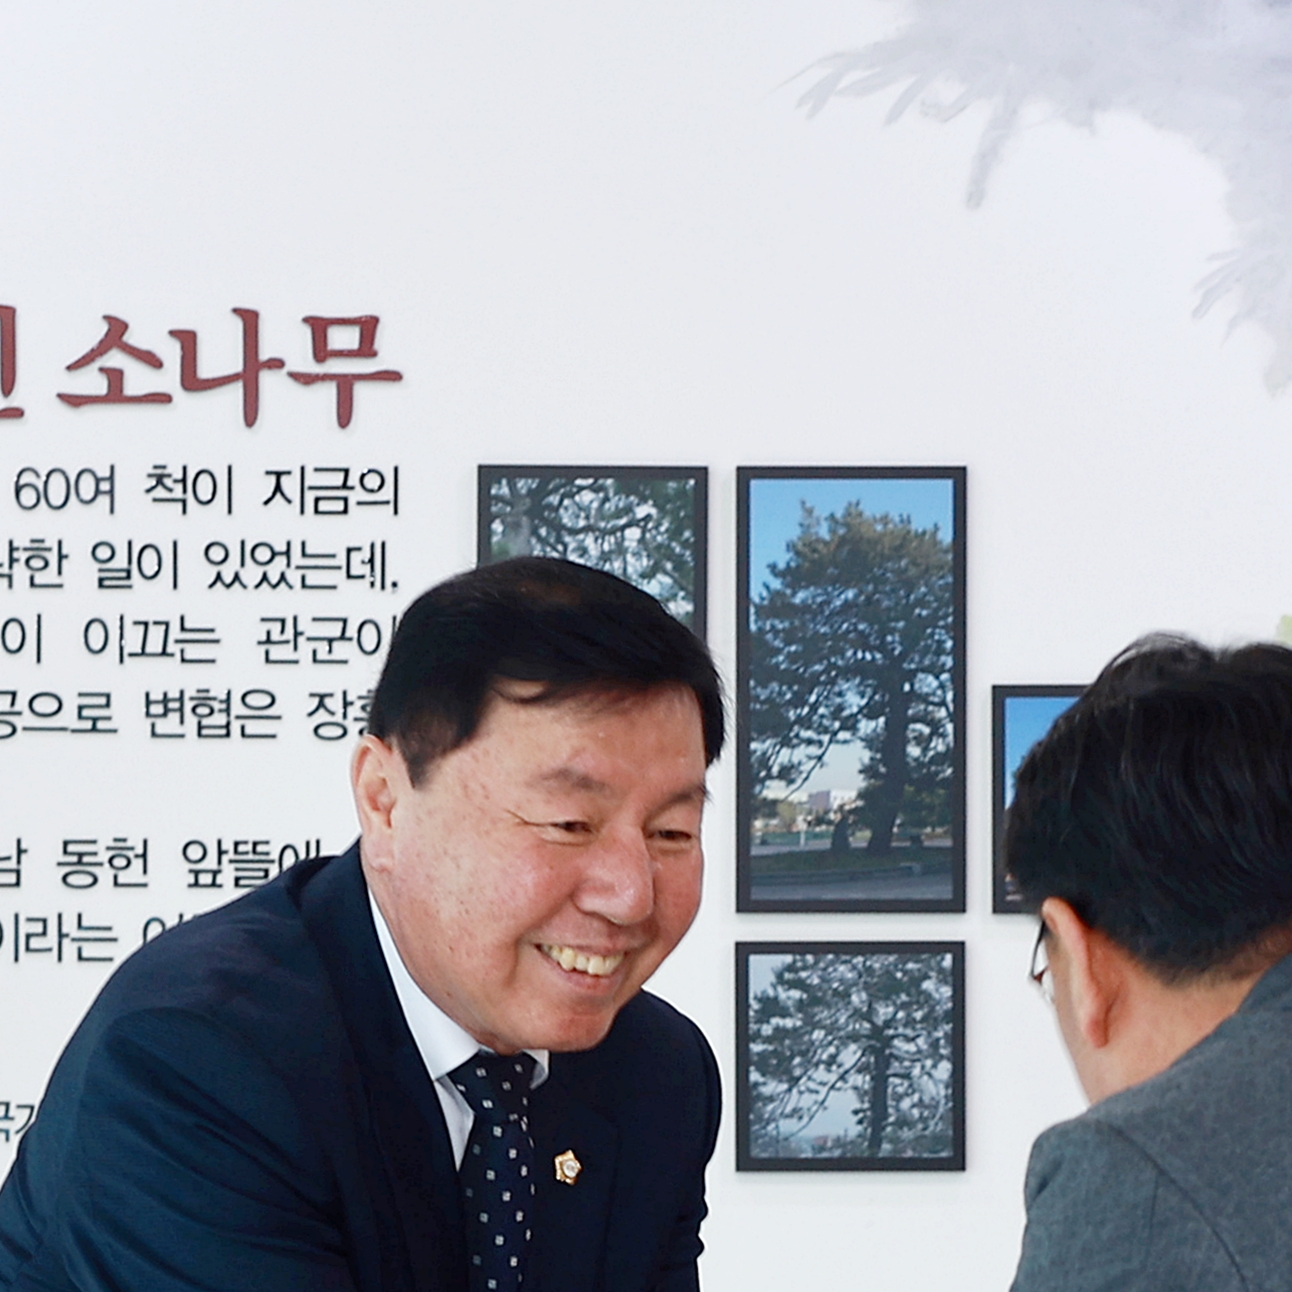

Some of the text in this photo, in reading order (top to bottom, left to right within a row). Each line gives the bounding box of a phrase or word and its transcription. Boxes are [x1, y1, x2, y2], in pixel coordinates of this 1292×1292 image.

[55, 307, 404, 430] 소나무
[13, 463, 116, 516] 60여
[144, 464, 233, 516] 척이
[262, 464, 400, 517] 지금의
[90, 538, 179, 591] 일이
[83, 613, 222, 666] 이끄는
[256, 614, 397, 665] 관군이
[144, 688, 283, 740] 변협은
[56, 837, 149, 890] 동헌
